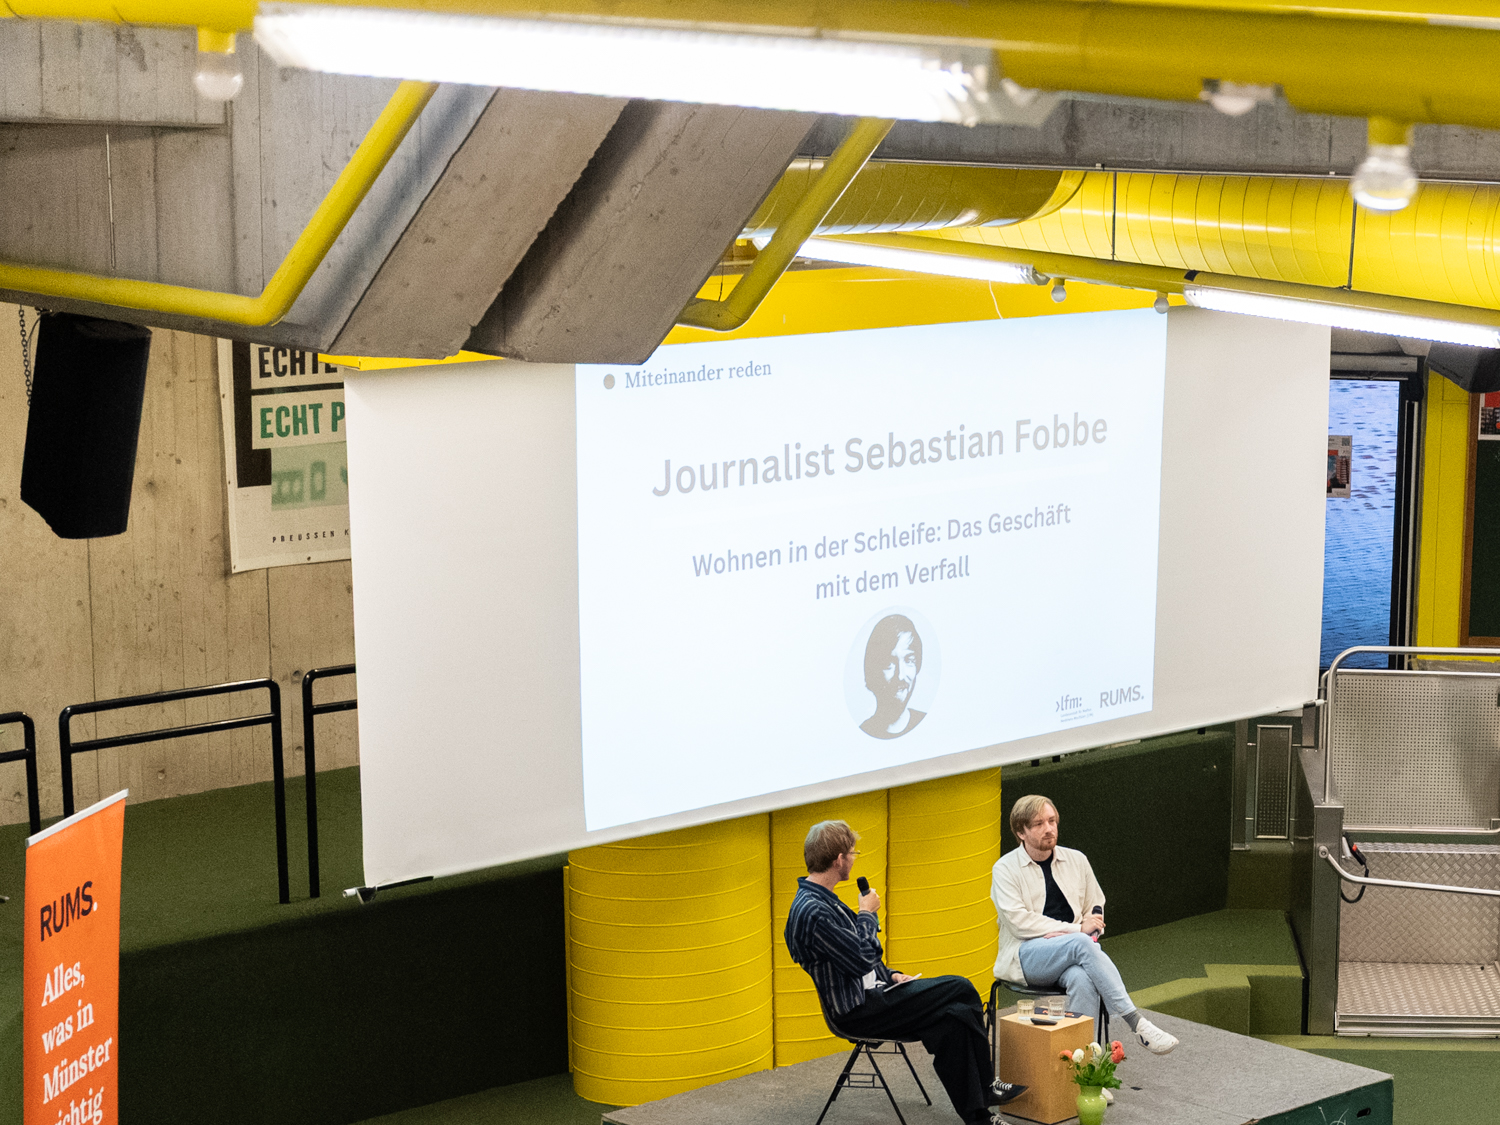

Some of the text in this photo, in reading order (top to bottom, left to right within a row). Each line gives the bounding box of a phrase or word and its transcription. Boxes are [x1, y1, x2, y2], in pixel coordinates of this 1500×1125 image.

[625, 361, 772, 388] Miteinander reden
[260, 402, 323, 438] ECHT
[652, 412, 1108, 496] Journalist Sebastian Fobbe
[692, 503, 1072, 577] Wohnen in der Schleife: Das Geschäft
[815, 555, 970, 600] mit dem Verfall
[1099, 684, 1144, 708] RUMS.
[40, 880, 98, 942] RUMS.
[41, 961, 85, 1007] Alles,
[41, 999, 94, 1054] was in
[42, 1037, 112, 1105] Münster
